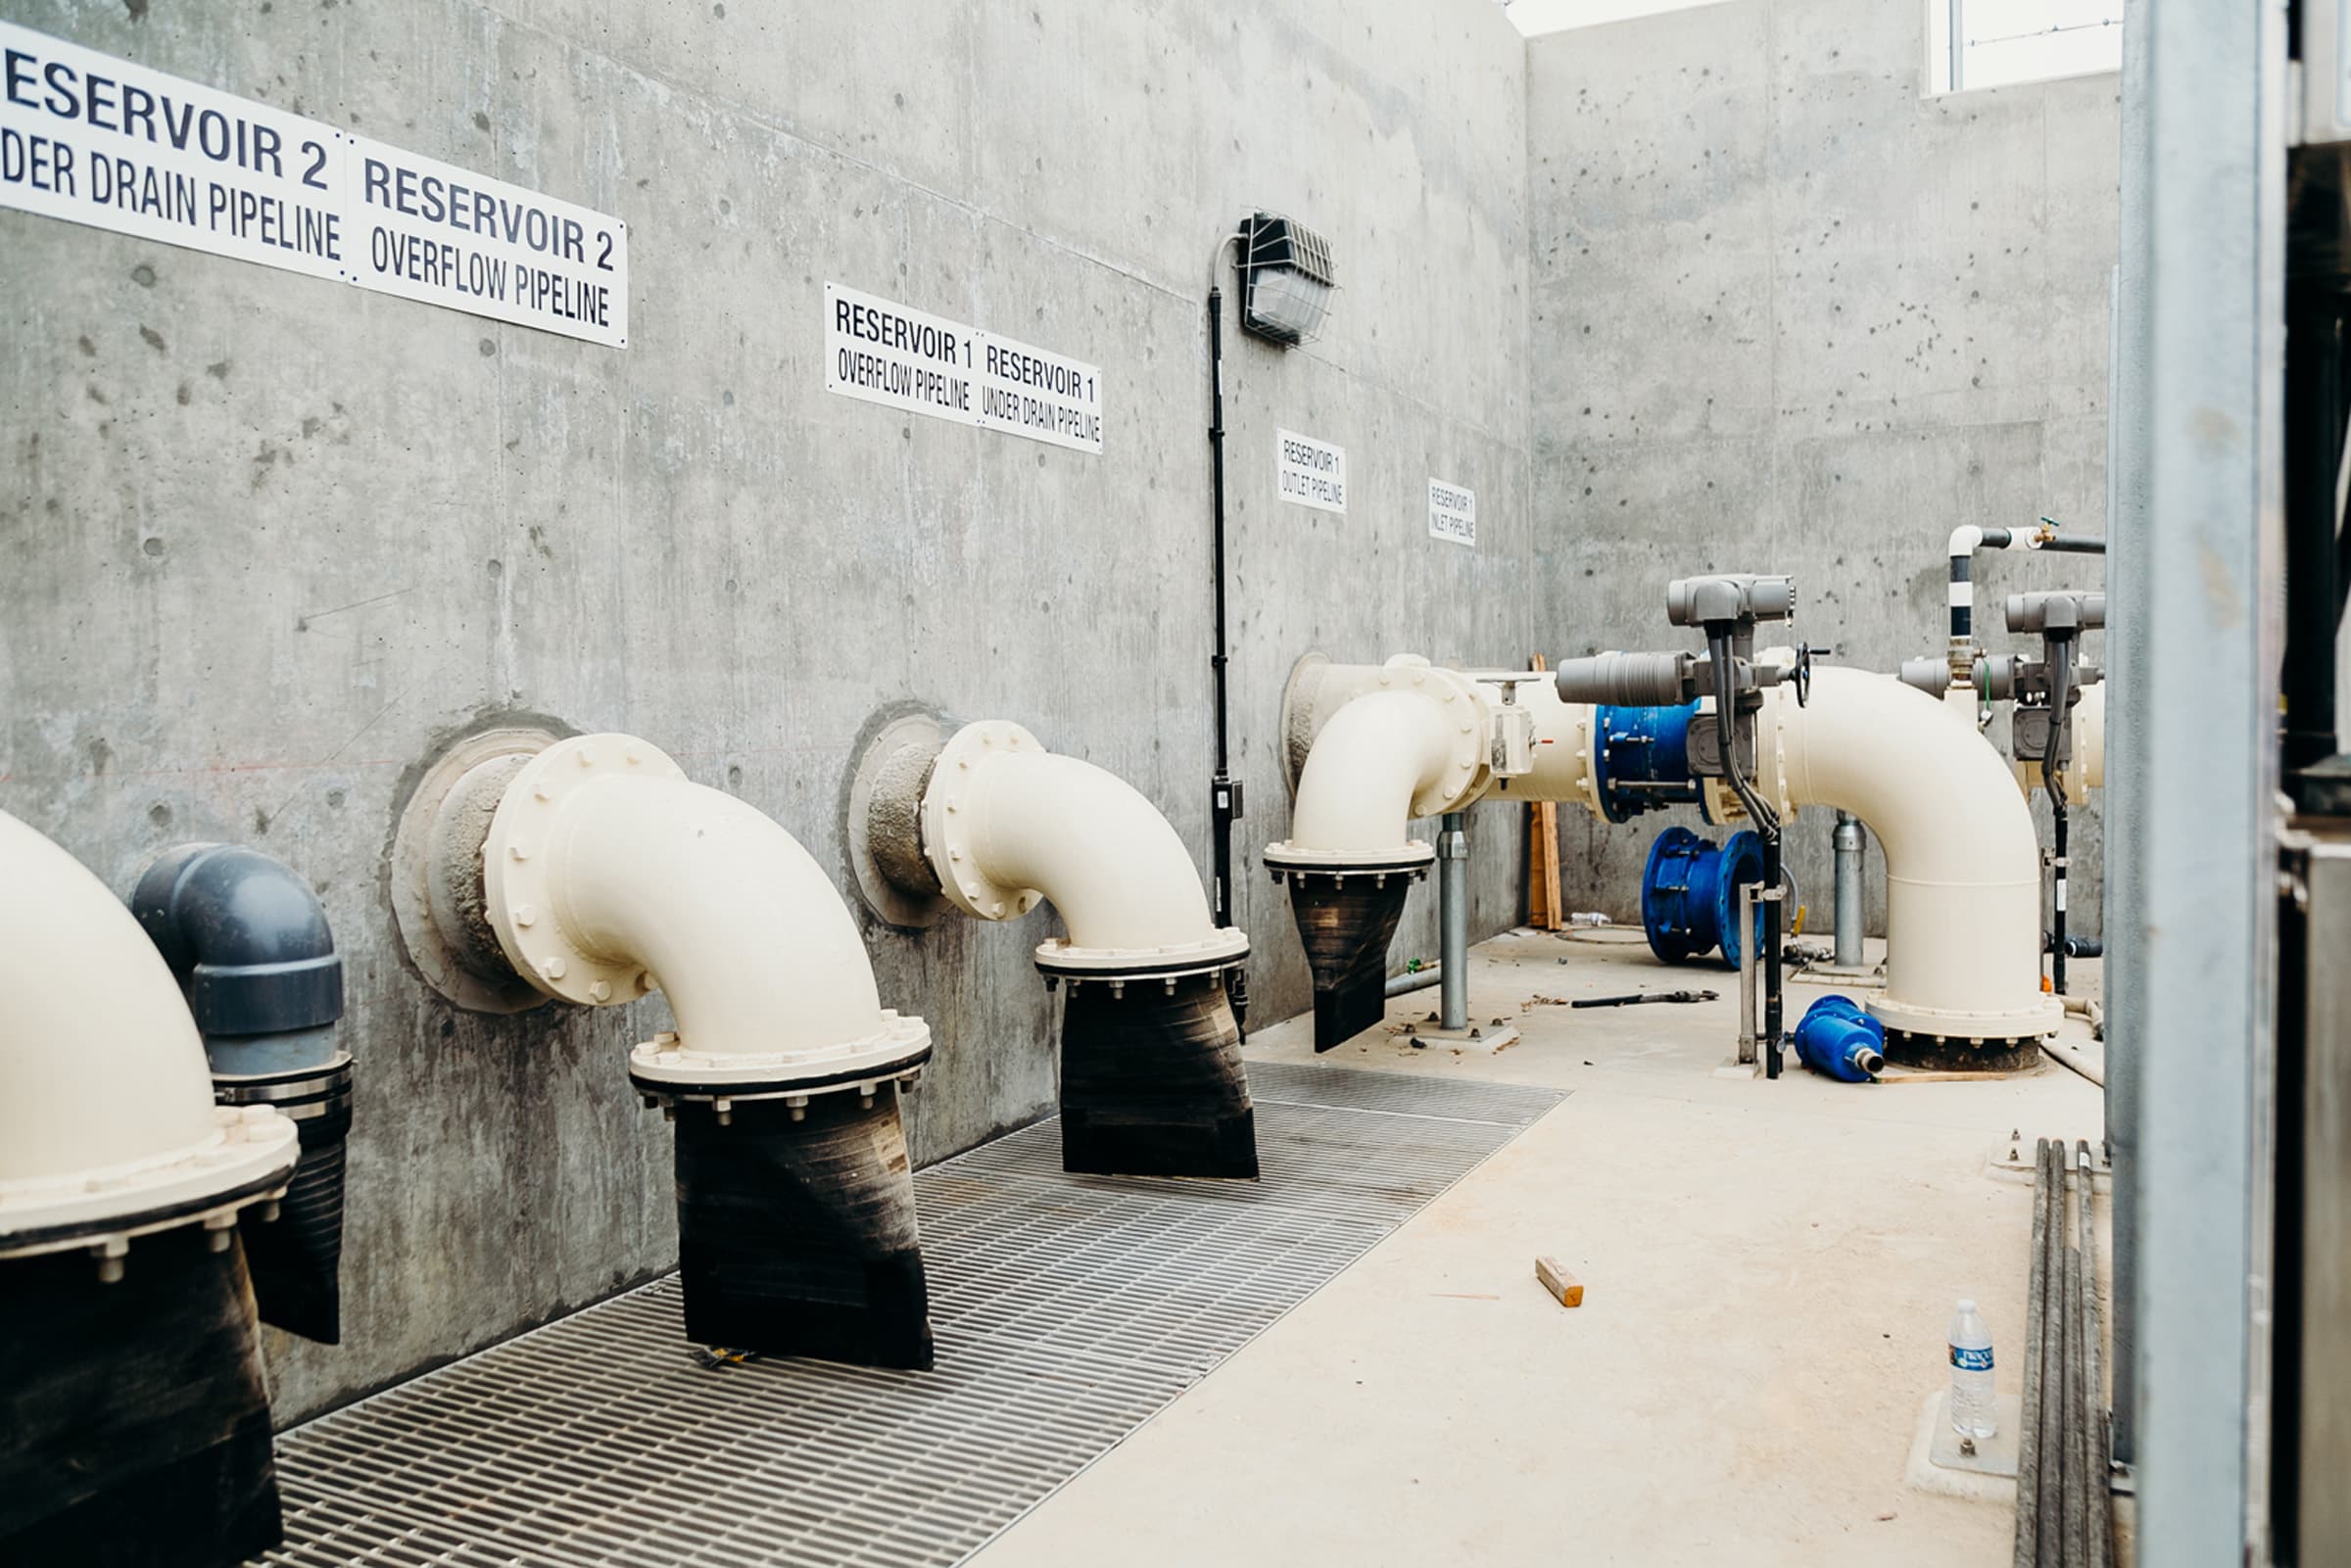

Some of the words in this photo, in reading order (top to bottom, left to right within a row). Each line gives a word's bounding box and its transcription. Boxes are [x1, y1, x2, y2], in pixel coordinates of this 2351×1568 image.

[2, 127, 75, 197] DER
[91, 151, 196, 226] DRAIN
[209, 182, 341, 261] PIPELINE
[301, 141, 328, 190] 2
[364, 158, 585, 263] RESERVOIR
[597, 231, 613, 271] 2
[372, 226, 506, 301] OVERFLOW
[515, 264, 609, 327] PIPELINE
[836, 299, 956, 365] RESERVOIR
[964, 340, 972, 368] 1
[839, 348, 912, 398] OVERFLOW
[916, 368, 970, 411] PIPELINE
[986, 345, 1081, 400] RESERVOIR
[1086, 377, 1094, 403] 1
[983, 385, 1021, 423] UNDER
[1024, 399, 1055, 432] DRAIN
[1058, 406, 1100, 443] PIPELINE
[1284, 440, 1333, 474] RESERVOIR
[1335, 456, 1339, 475] 1
